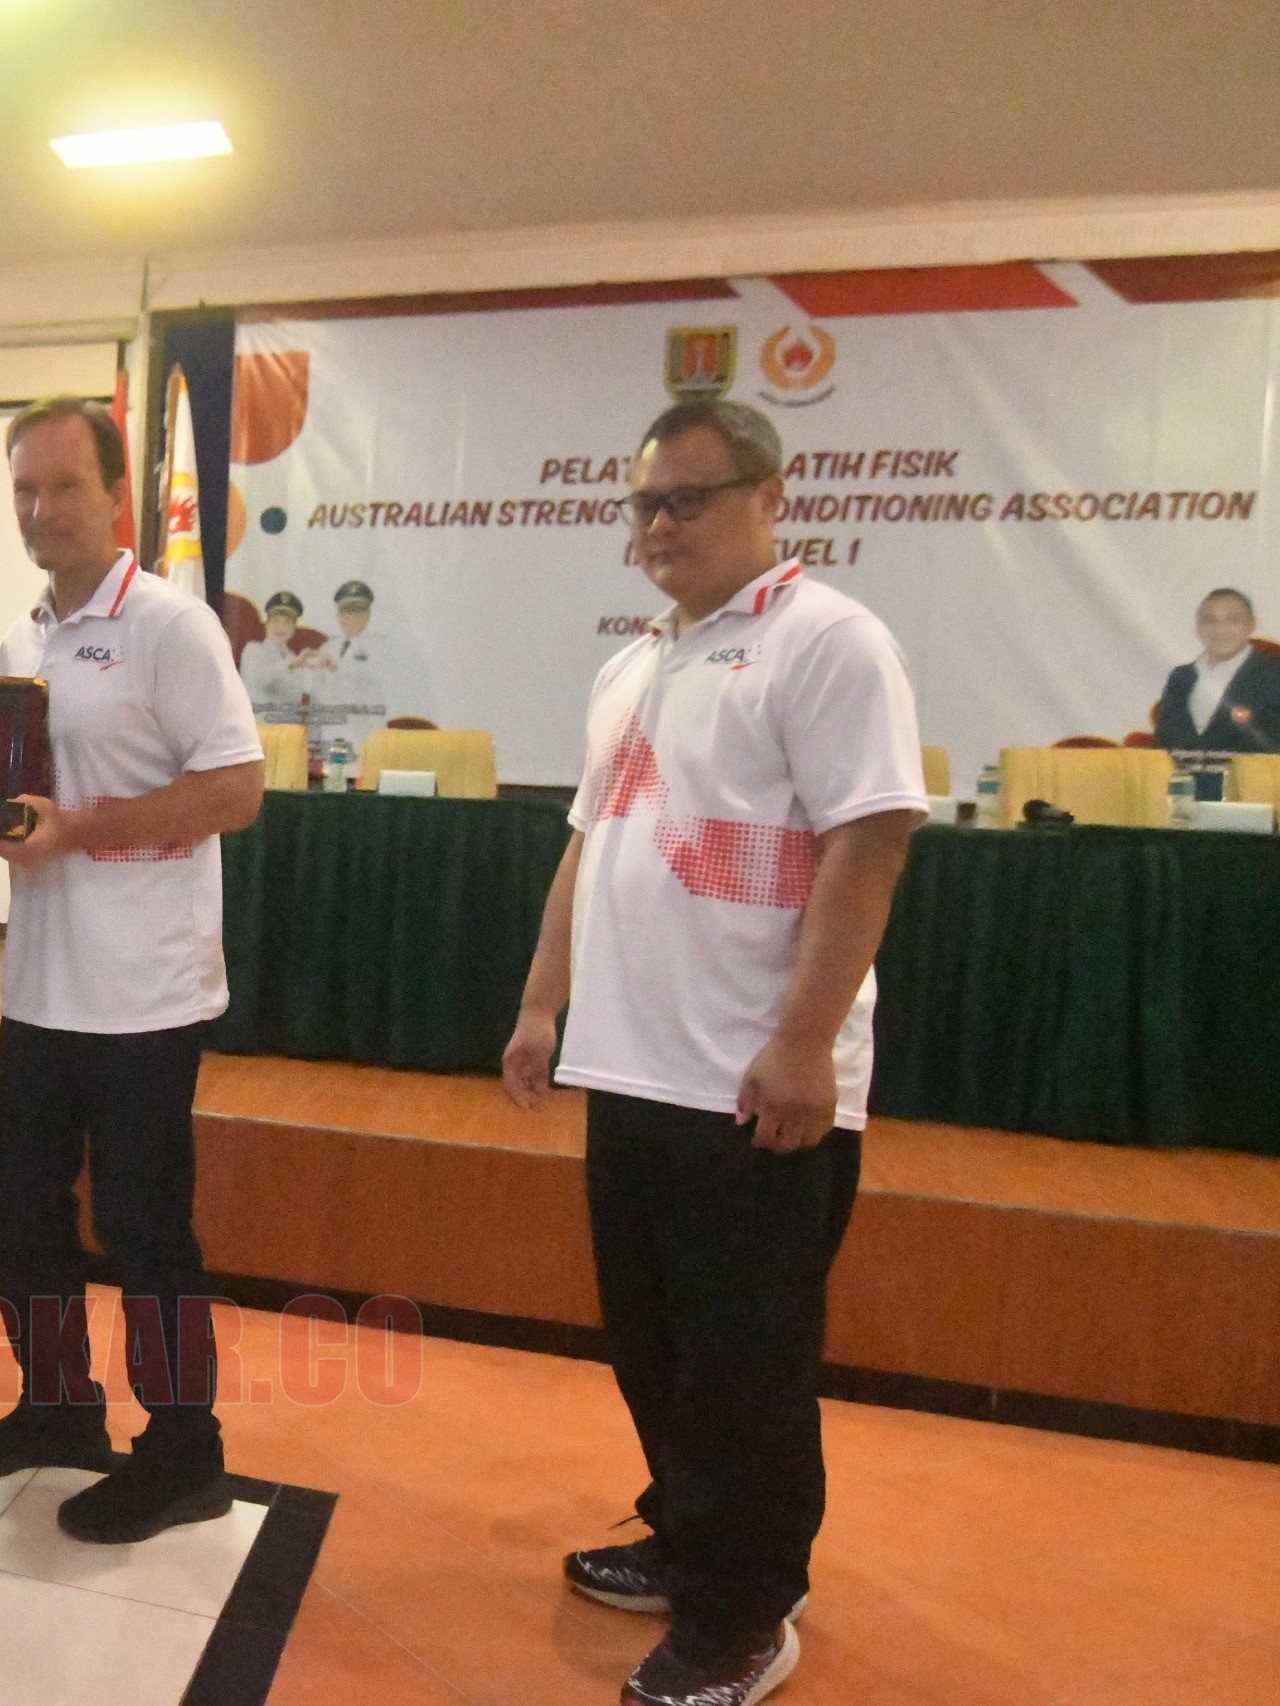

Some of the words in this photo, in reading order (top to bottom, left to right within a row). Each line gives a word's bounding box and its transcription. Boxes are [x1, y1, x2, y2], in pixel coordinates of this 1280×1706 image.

[784, 451, 865, 480] ATIH
[871, 450, 959, 479] FISIK
[308, 499, 494, 528] AUSTRALIAN
[497, 497, 619, 527] STRENG
[776, 493, 993, 523] ONDITIONING
[1000, 490, 1259, 522] ASSOCIATION
[75, 645, 112, 661] ASCA
[705, 649, 744, 663] ASCA
